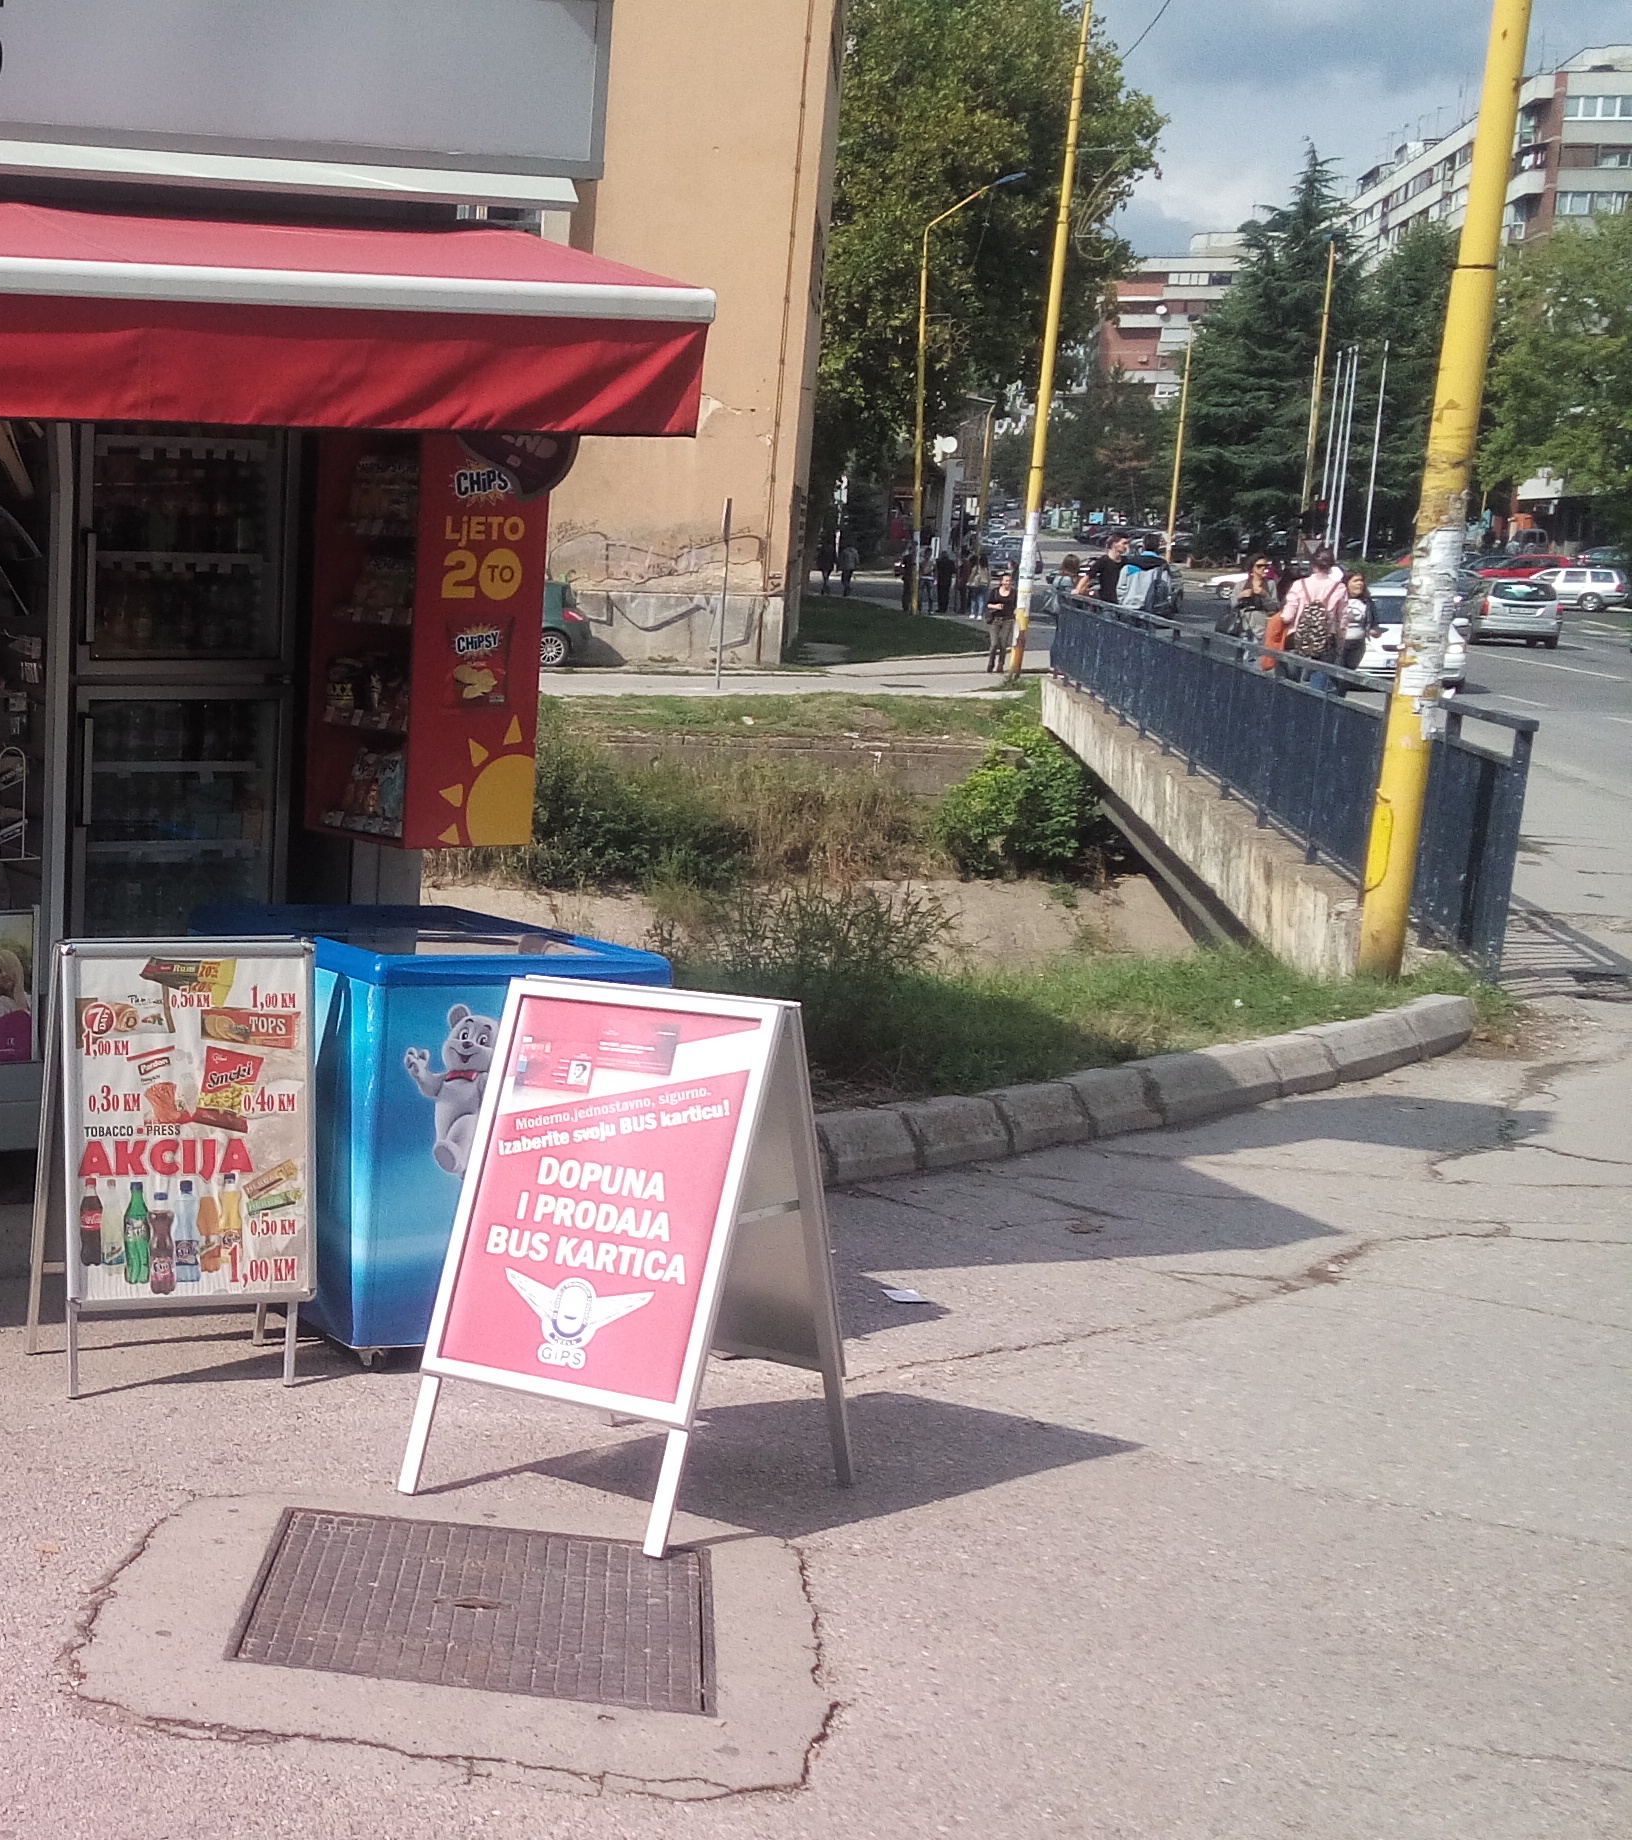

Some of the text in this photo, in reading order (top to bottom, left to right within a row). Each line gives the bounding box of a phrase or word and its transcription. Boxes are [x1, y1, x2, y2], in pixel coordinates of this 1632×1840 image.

[487, 564, 515, 583] TO
[171, 987, 195, 1009] 0,50
[196, 993, 210, 1008] KM
[251, 985, 296, 1011] 1,00 KM
[249, 1016, 286, 1035] TOPS
[84, 1031, 130, 1059] 1,00 KM
[139, 1058, 169, 1074] Pardon
[207, 1062, 253, 1088] Smoki
[88, 1085, 141, 1115] 0,30 KM
[244, 1086, 296, 1114] 0,40 KM
[84, 1124, 181, 1138] TOBACCO PRESS
[498, 1099, 730, 1156] Izaberite svoju BUS karticu!
[78, 1138, 254, 1182] AKCIJA
[537, 1156, 665, 1202] DOPUNA
[250, 1212, 296, 1238] 0,50 KM
[516, 1191, 670, 1243] I PRODAJA
[228, 1244, 269, 1288] 1,00
[273, 1258, 296, 1282] KM
[485, 1224, 686, 1286] BUS KARTICA
